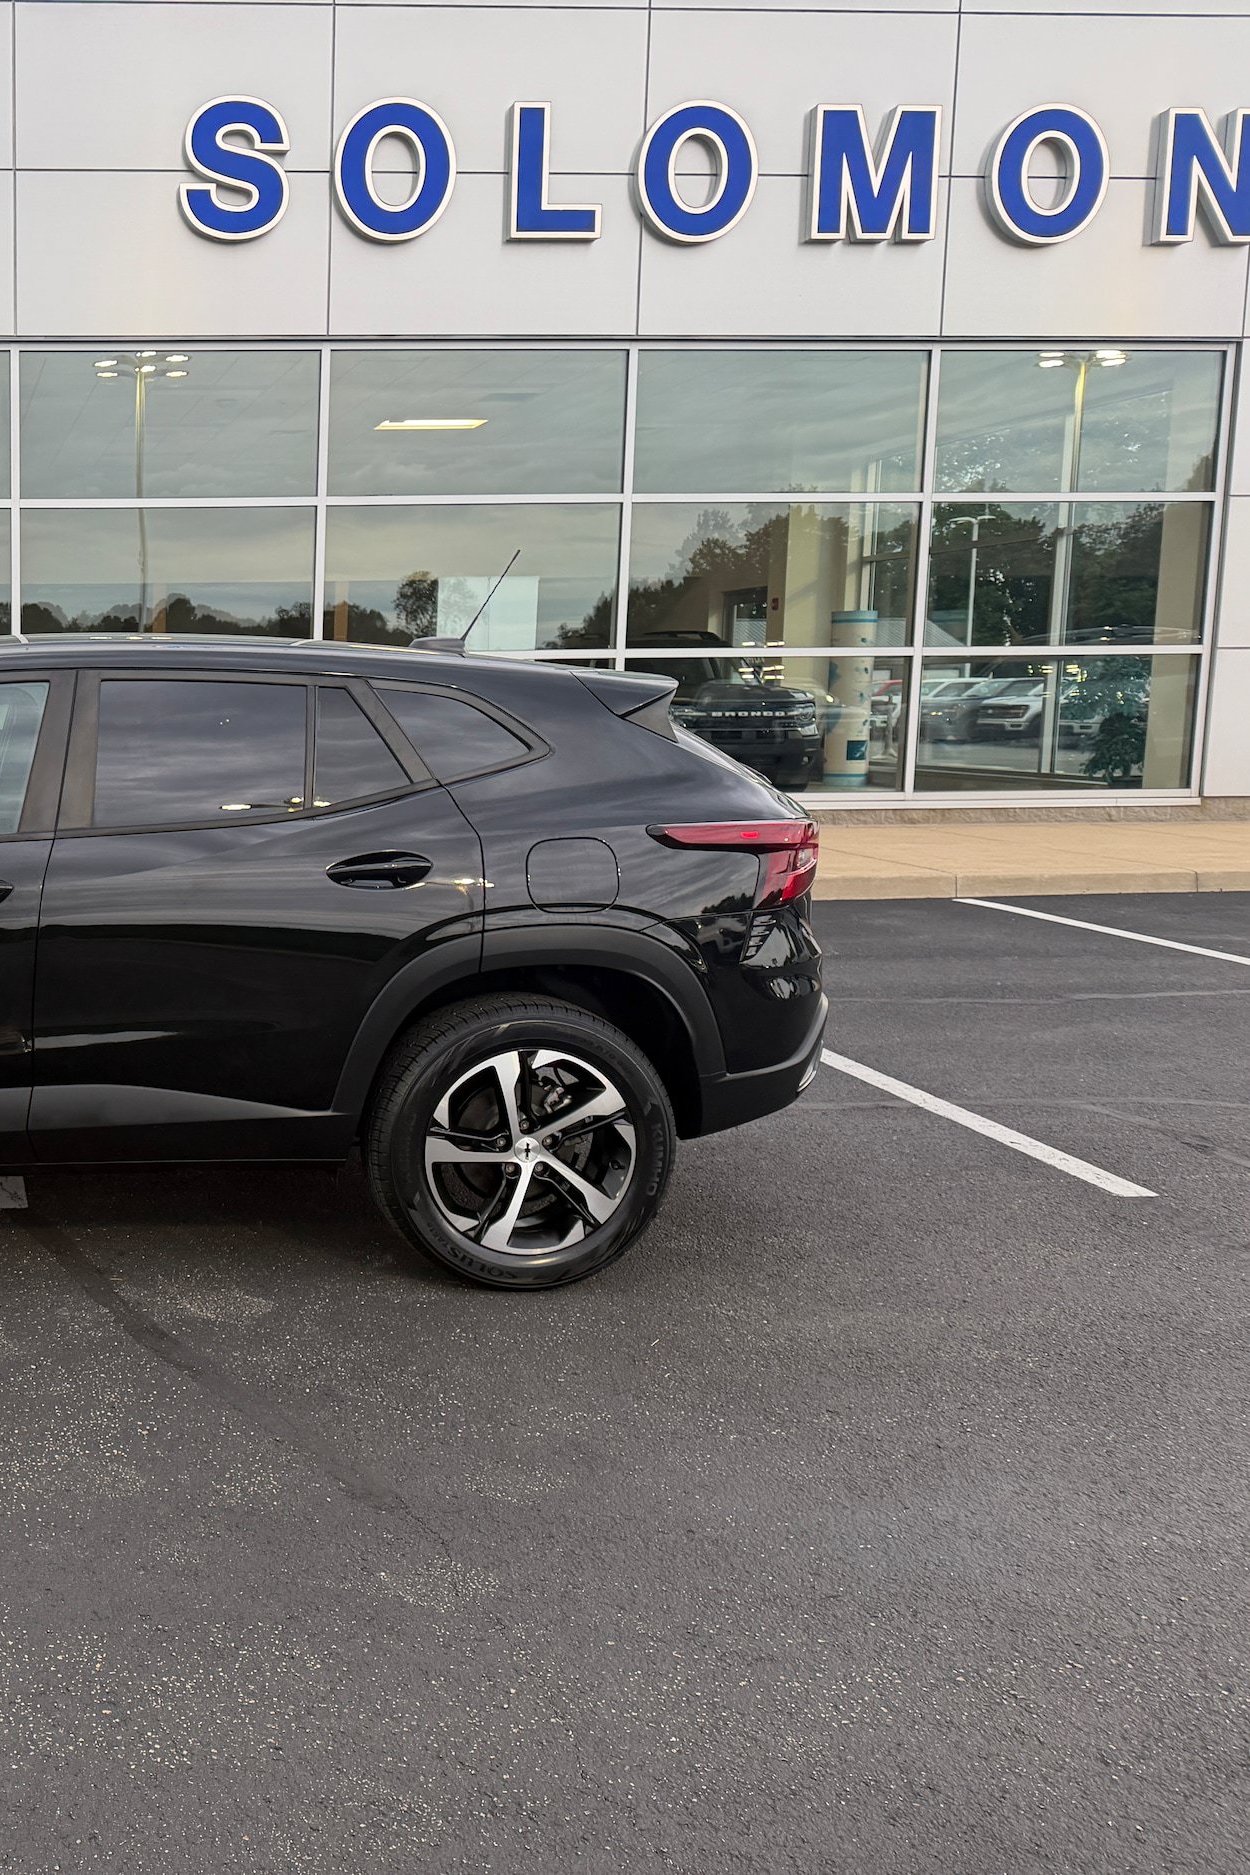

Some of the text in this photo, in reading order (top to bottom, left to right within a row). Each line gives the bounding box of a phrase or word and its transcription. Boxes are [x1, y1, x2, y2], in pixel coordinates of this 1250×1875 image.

[178, 94, 1250, 247] SOLOMON
[645, 1122, 665, 1197] KUMHO
[446, 1245, 519, 1280] SOLUS
